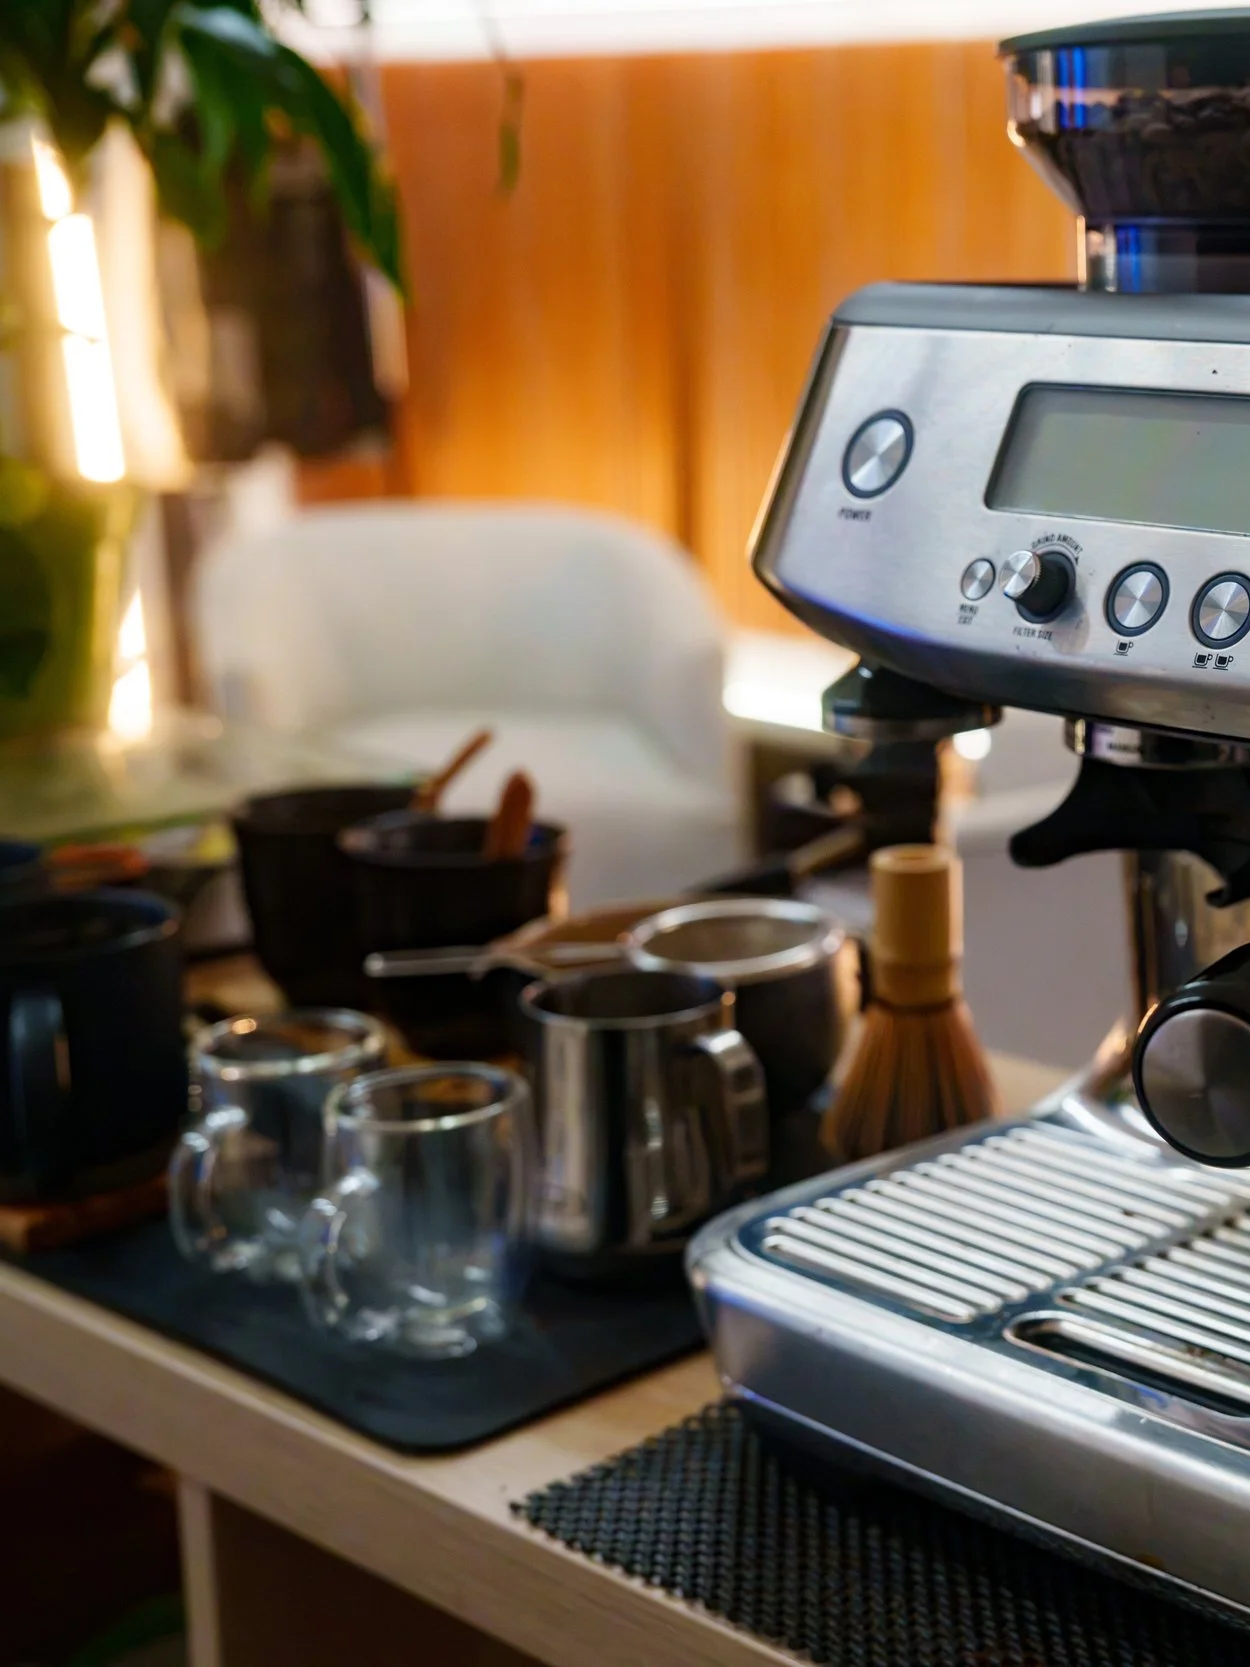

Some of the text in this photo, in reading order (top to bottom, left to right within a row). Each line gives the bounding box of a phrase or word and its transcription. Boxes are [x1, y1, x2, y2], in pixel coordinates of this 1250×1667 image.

[838, 506, 871, 521] POWER
[1012, 626, 1053, 641] FILTER SIZE
